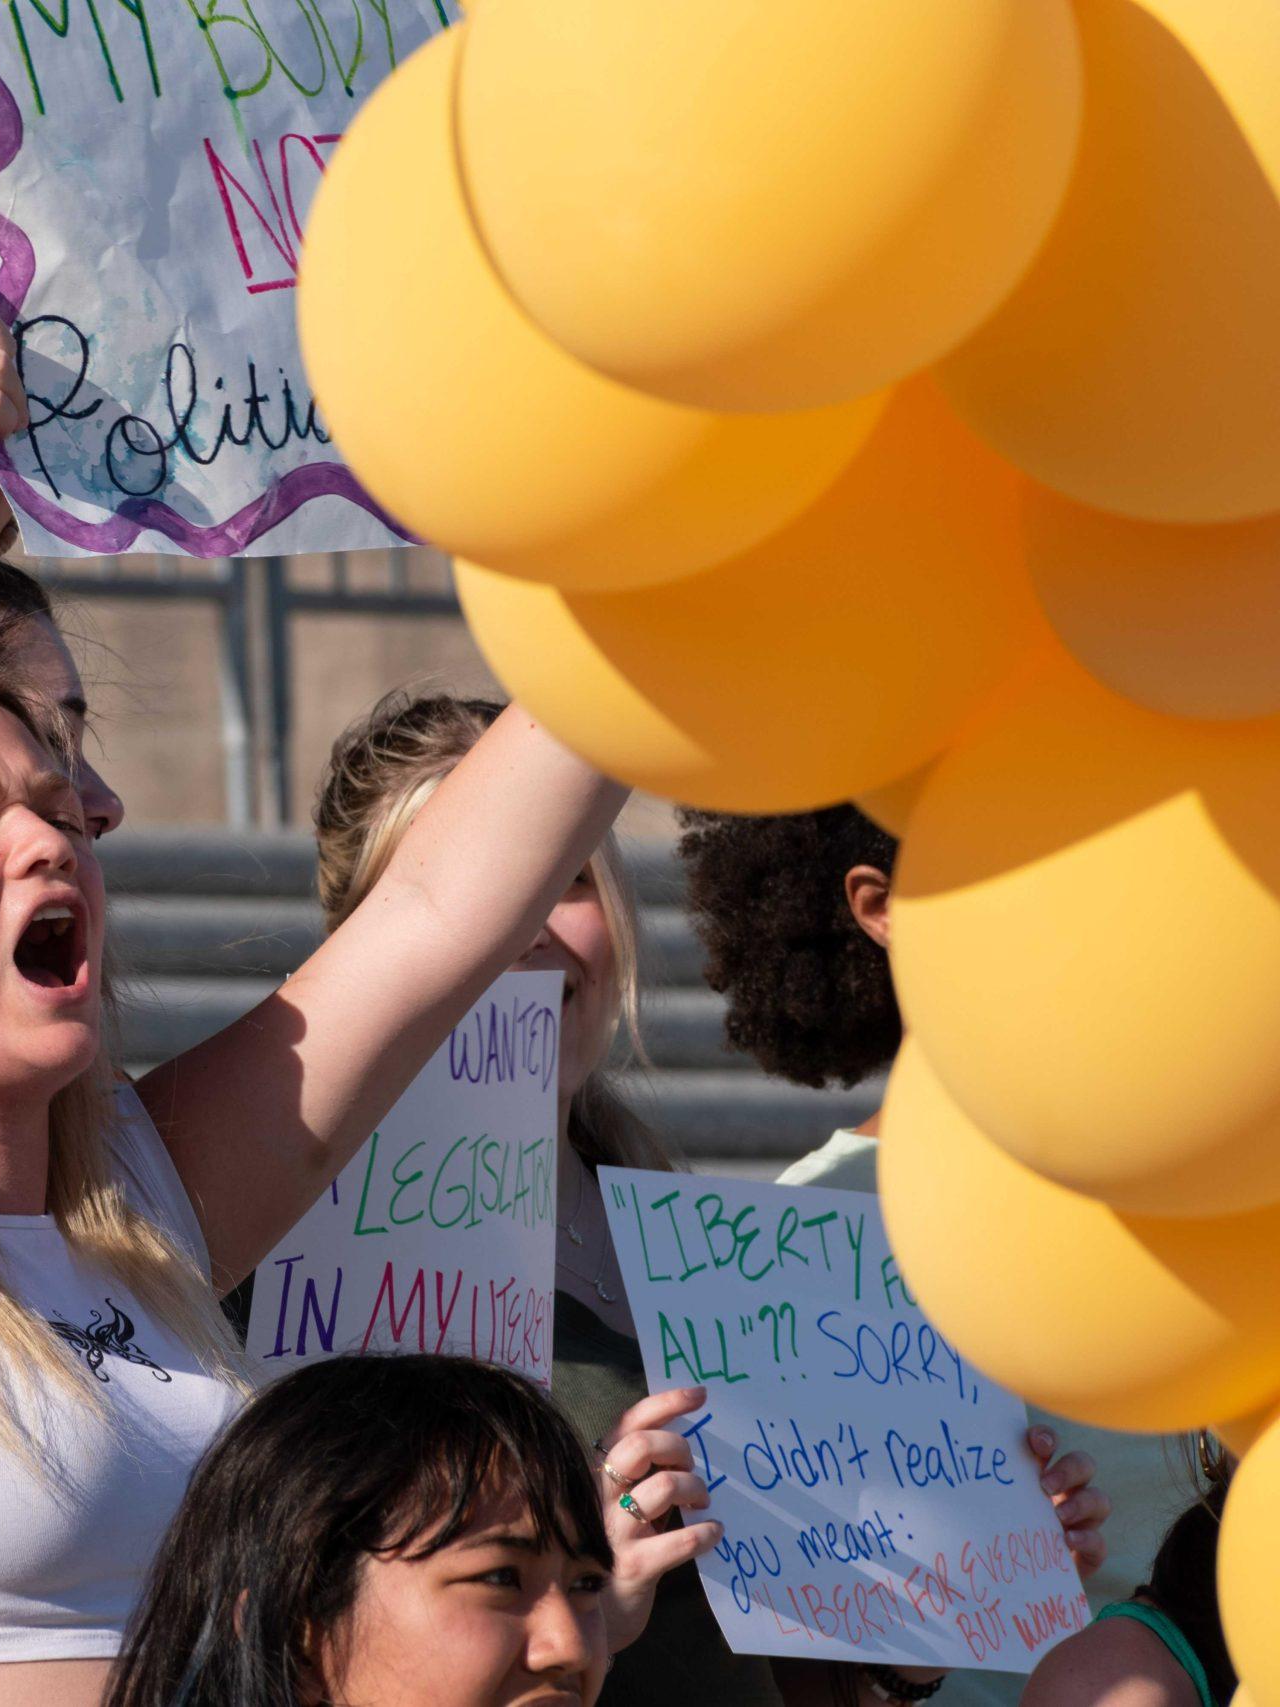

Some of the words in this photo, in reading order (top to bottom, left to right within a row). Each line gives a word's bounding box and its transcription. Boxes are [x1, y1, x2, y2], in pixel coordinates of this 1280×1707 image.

[9, 0, 162, 115] MY
[449, 996, 559, 1092] WANTED
[611, 1182, 865, 1300] "LIBERTY
[263, 1254, 343, 1360] IN
[358, 1260, 464, 1357] MY
[681, 1413, 727, 1492] I
[743, 1418, 870, 1491] didn't
[884, 1420, 1015, 1488] realize
[714, 1534, 782, 1615] you
[751, 1575, 907, 1645] "LIBERTY
[903, 1552, 967, 1623] FOR
[960, 1527, 1070, 1604] EVERYONE
[956, 1598, 1008, 1662] BUT
